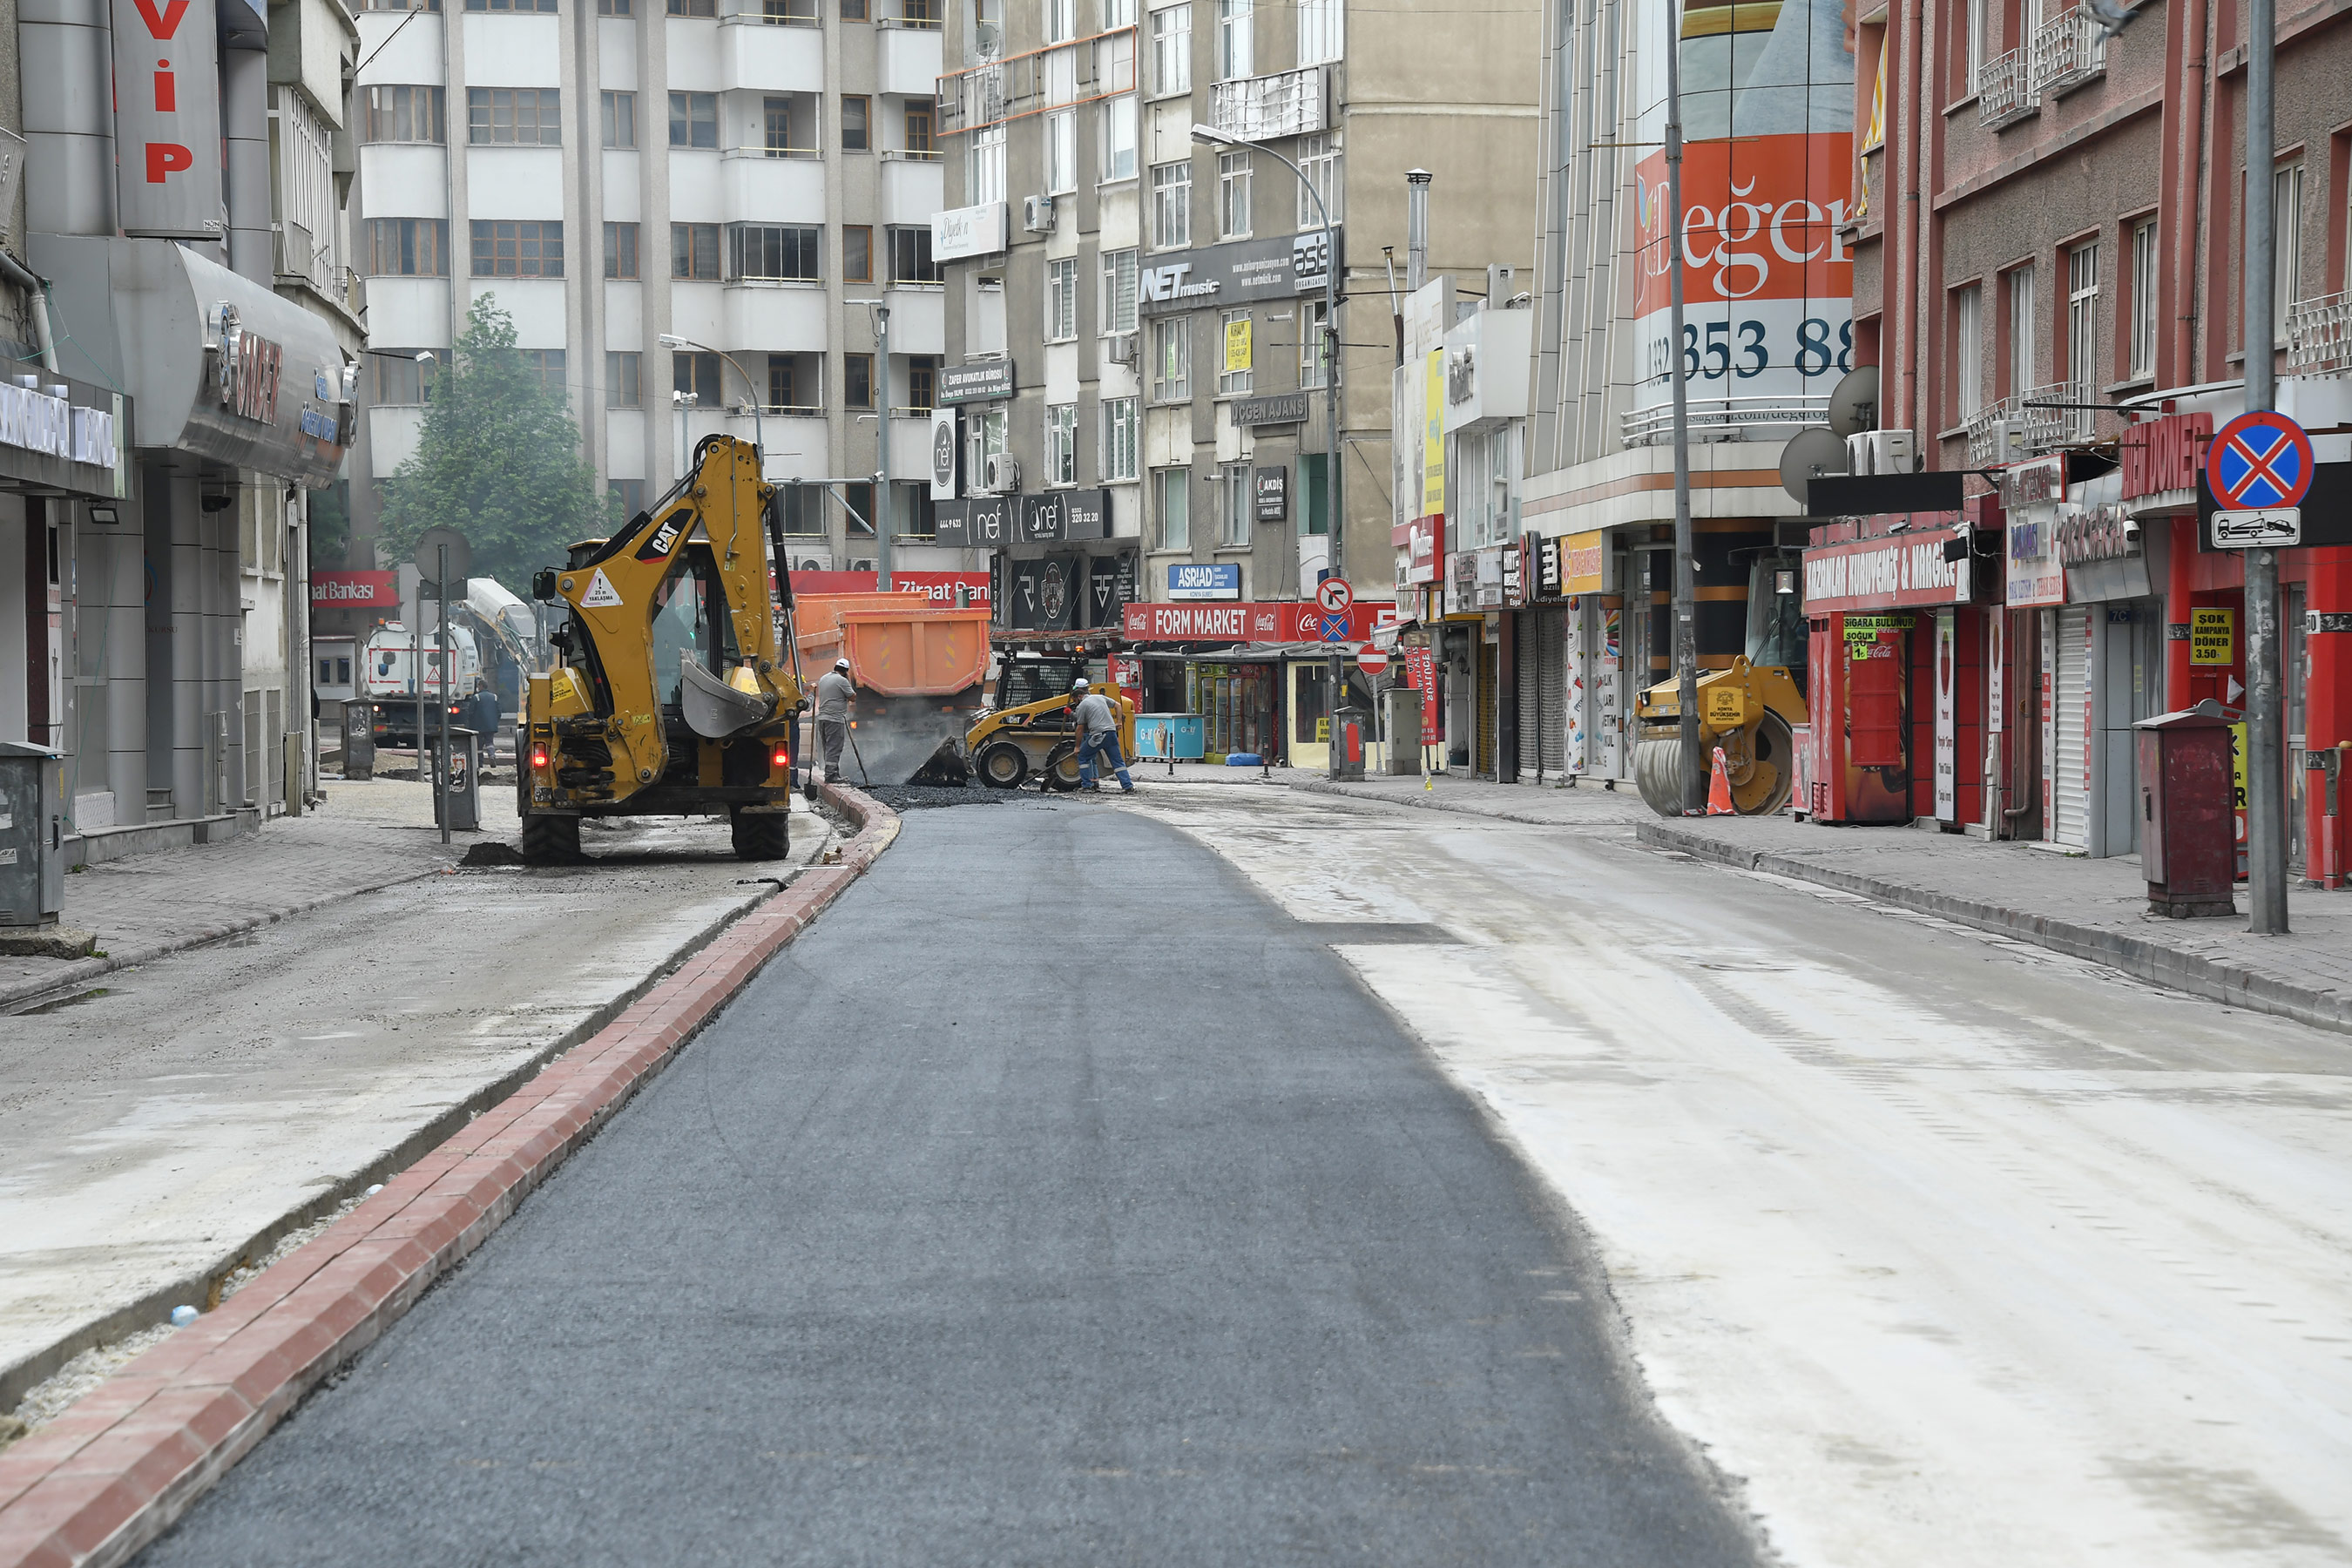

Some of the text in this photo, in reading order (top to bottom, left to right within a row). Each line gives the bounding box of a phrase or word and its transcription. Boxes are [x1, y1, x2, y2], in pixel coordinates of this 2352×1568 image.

[1139, 263, 1192, 303] NET
[1683, 320, 1768, 382] 353
[949, 368, 1003, 386] ZAFER AVUKATLIK BÜROSU
[1232, 398, 1304, 424] ÜÇGEN AJANS
[936, 442, 950, 467] nef
[1264, 476, 1283, 493] AKDİŞ
[949, 519, 952, 529] 9
[977, 503, 1002, 540] nef
[1071, 512, 1098, 523] 320 32 20
[652, 522, 679, 554] CAT
[1806, 537, 1955, 601] KAZANLAR KURUYEMİŞ & NARGİLE
[328, 580, 374, 599] Bankası
[589, 594, 613, 603] YAKLAŞMA
[899, 580, 951, 600] Ziraat
[1155, 609, 1247, 635] FORM MARKET
[1844, 618, 1913, 628] SİGARA BULUNUR
[2112, 611, 2126, 621] 7C
[2199, 614, 2225, 624] ŞOK
[1846, 629, 1873, 640] SOĞUK
[2194, 625, 2230, 634] KAMPANYA
[2194, 636, 2228, 646] DÖNER
